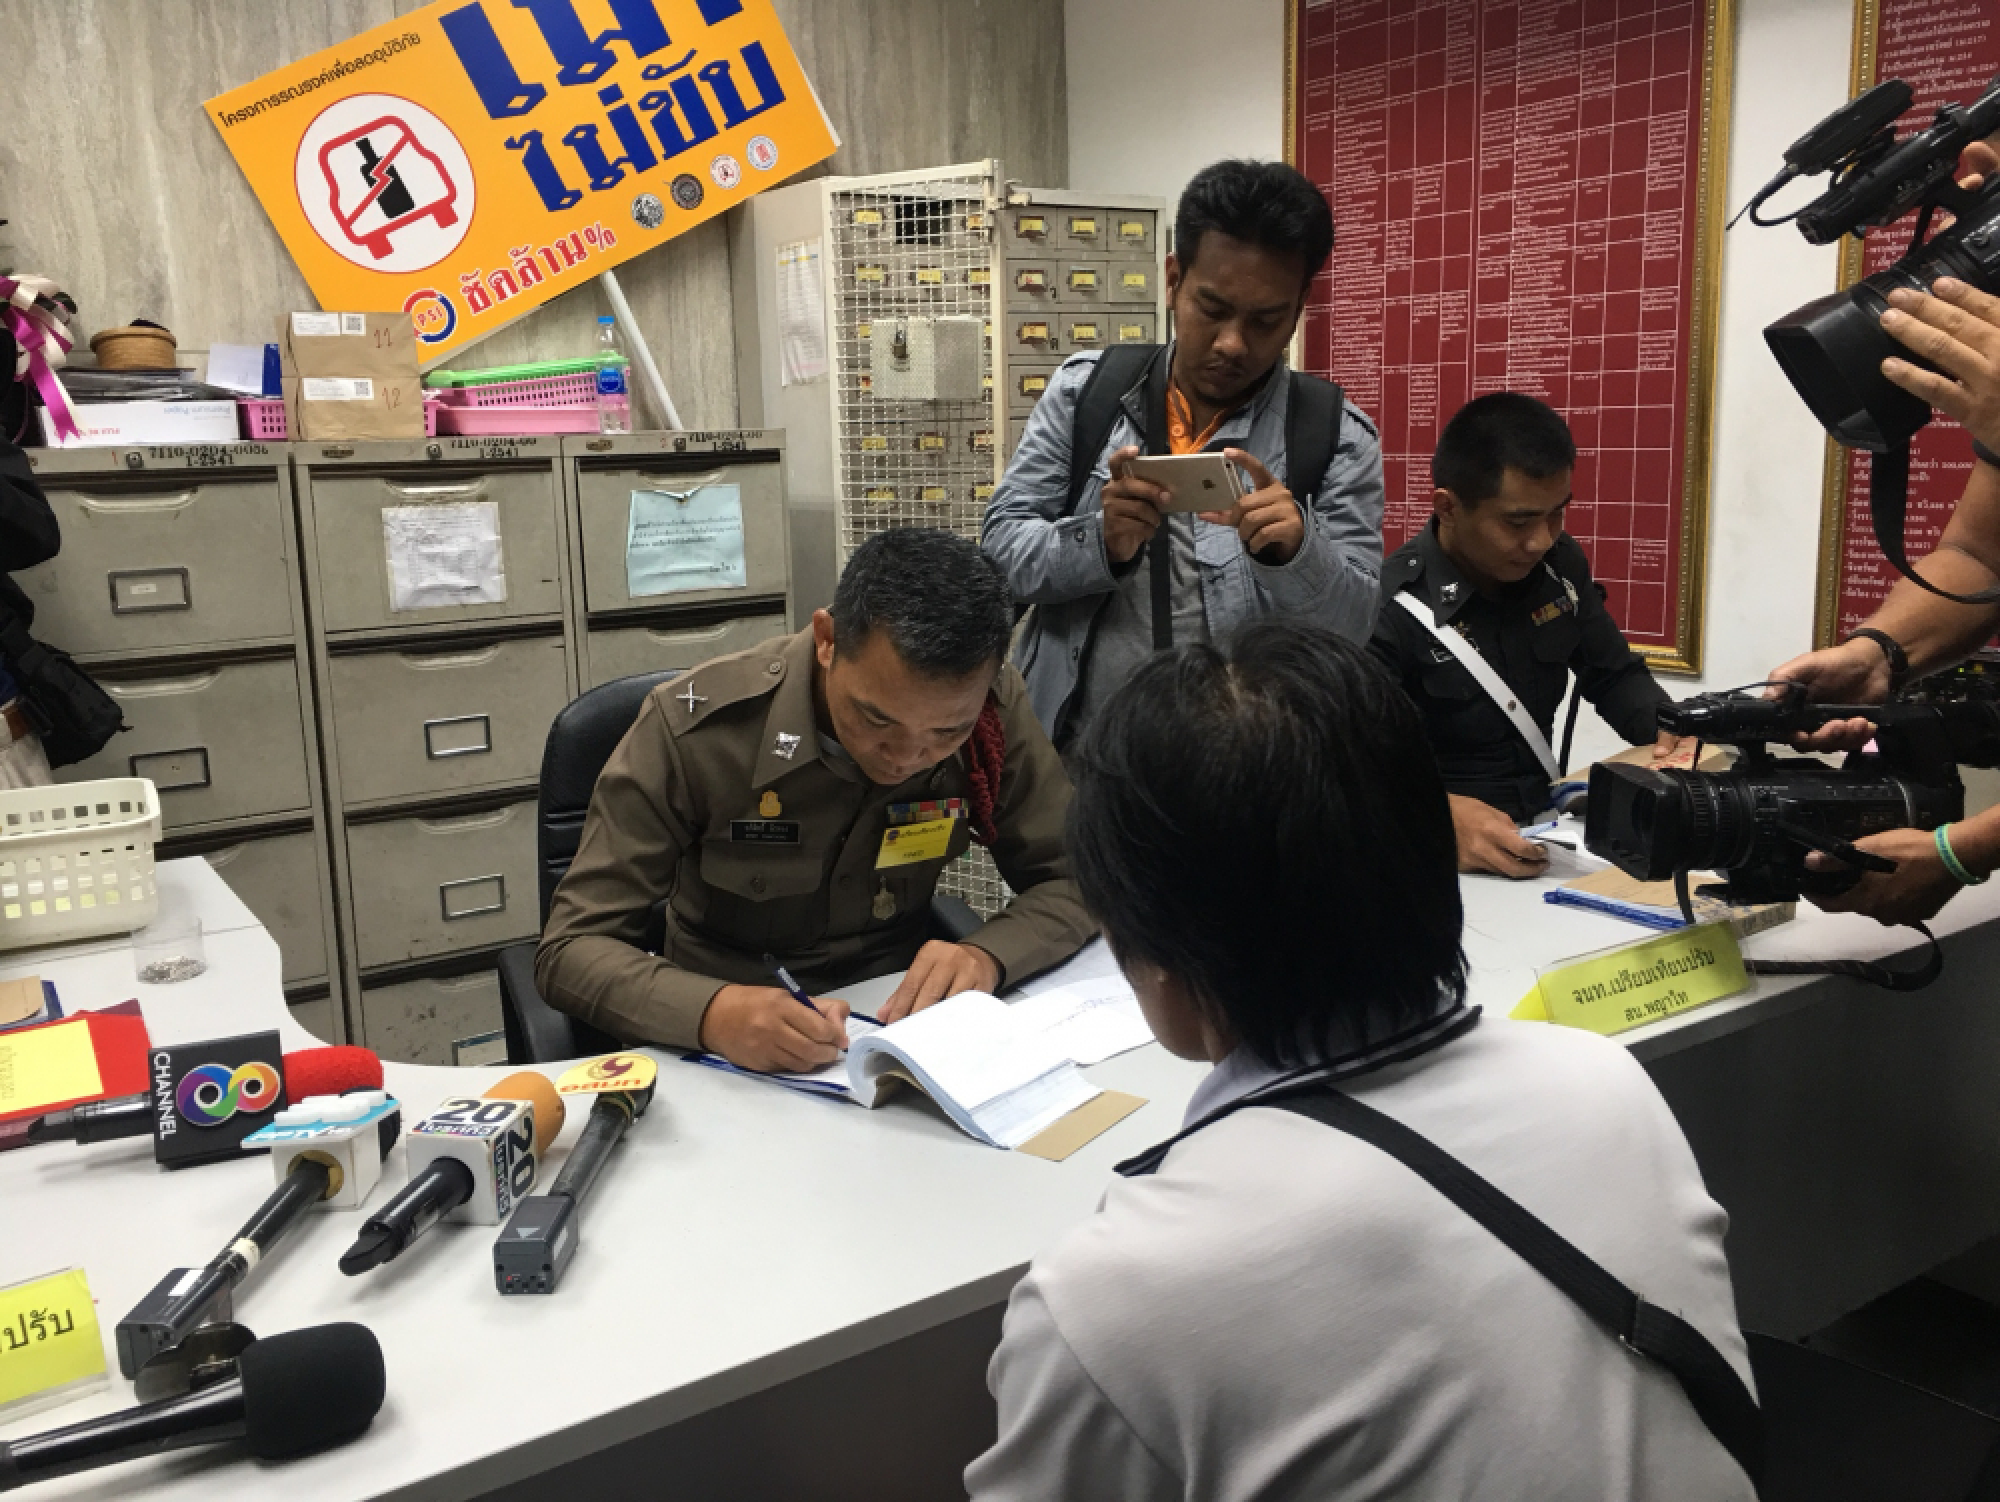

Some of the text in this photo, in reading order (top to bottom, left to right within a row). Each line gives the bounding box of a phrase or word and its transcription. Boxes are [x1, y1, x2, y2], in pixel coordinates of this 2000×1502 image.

[504, 40, 786, 213] ไม่ขับ
[373, 326, 395, 350] 11
[153, 1051, 177, 1141] CHANNEL
[430, 1099, 517, 1123] 20
[507, 1116, 535, 1199] 20
[0, 1307, 75, 1354] ปรับ
